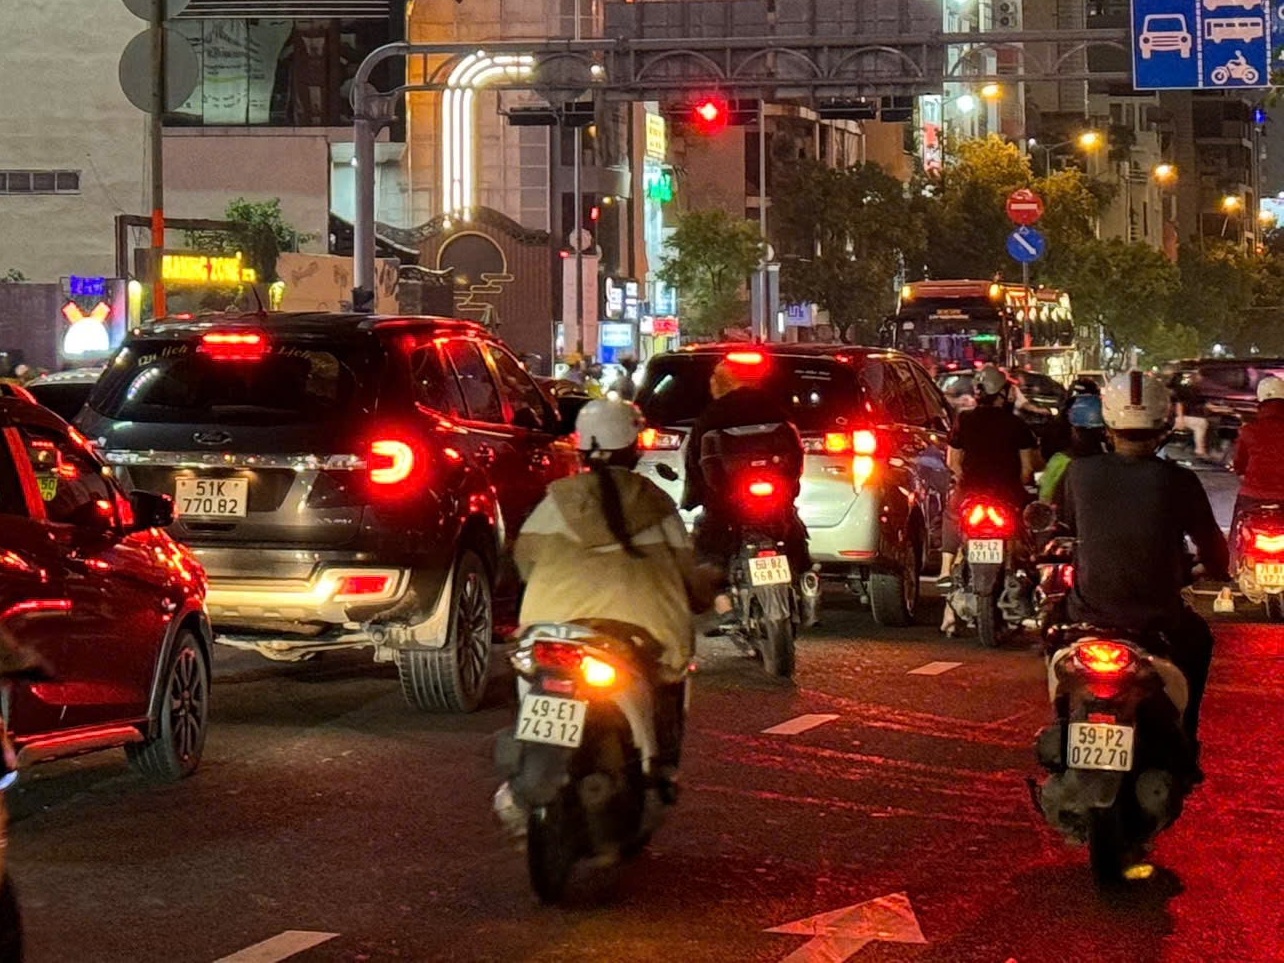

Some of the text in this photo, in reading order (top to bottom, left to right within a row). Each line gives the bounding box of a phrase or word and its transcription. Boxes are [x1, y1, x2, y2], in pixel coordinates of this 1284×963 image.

[195, 481, 227, 497] 51K
[182, 498, 238, 514] 770.82
[531, 698, 576, 722] 49-E1
[1078, 725, 1125, 748] 59-P2
